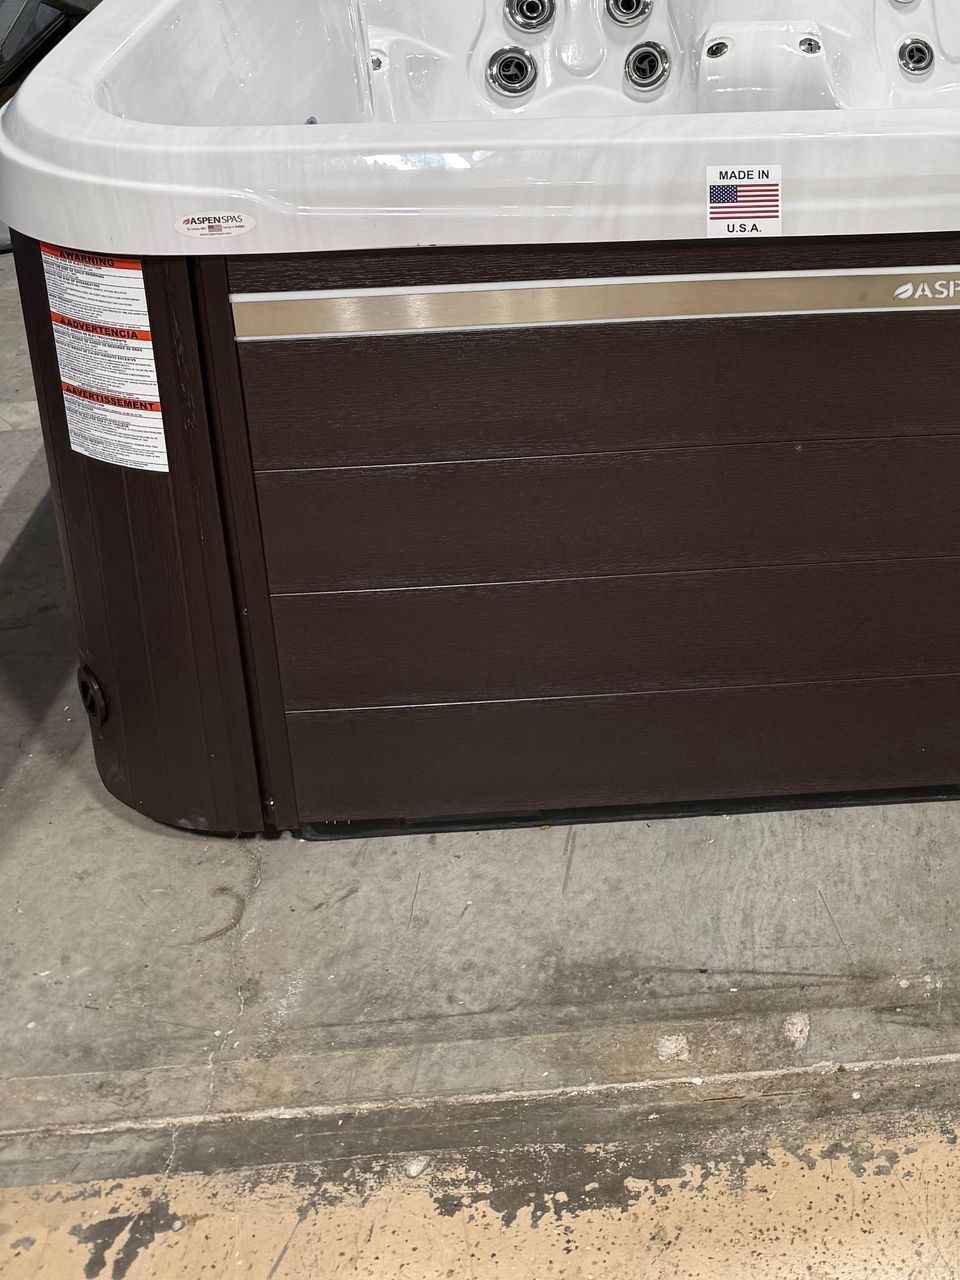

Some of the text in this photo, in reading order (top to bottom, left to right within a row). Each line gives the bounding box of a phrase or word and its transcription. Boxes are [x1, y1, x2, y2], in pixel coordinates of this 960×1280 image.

[719, 169, 770, 181] MADE IN
[191, 215, 242, 224] ASPEN SPAS
[727, 223, 762, 233] U.S.A.
[65, 253, 115, 266] WARNING
[65, 318, 138, 339] ADVERTENCIA
[74, 388, 154, 410] AVERTISSEMENT
